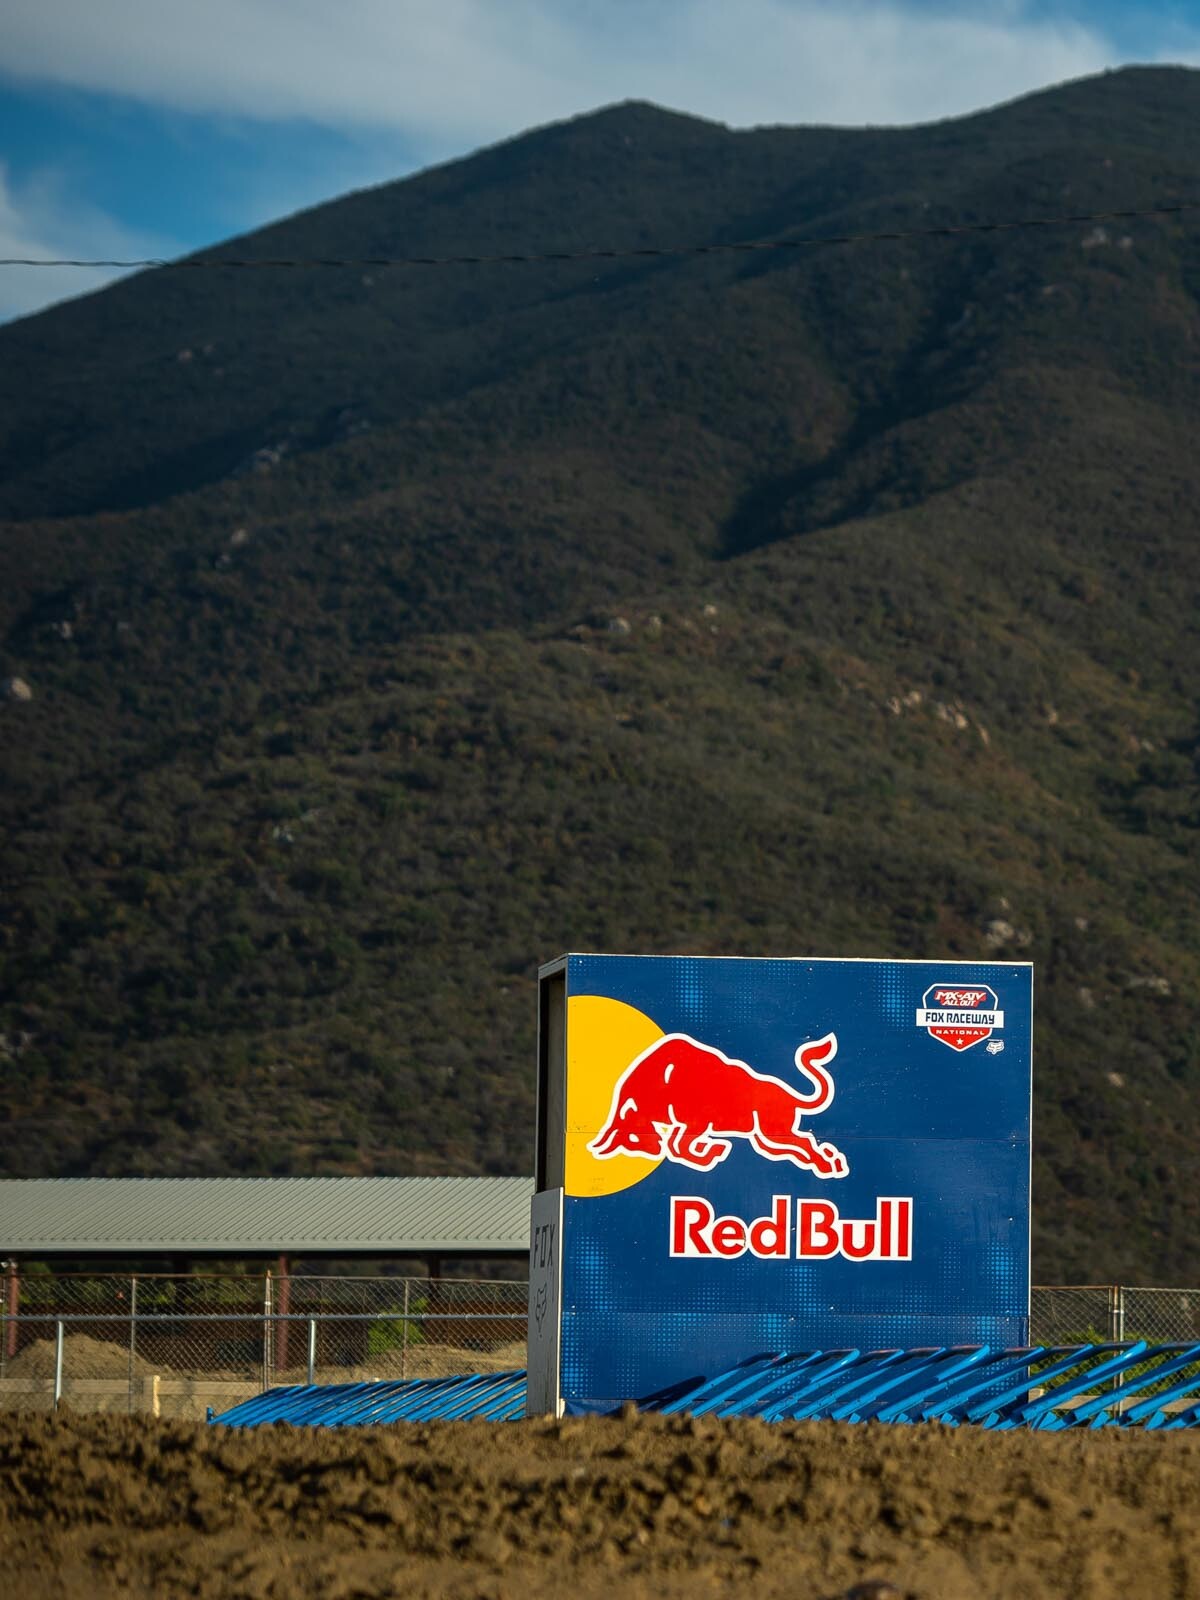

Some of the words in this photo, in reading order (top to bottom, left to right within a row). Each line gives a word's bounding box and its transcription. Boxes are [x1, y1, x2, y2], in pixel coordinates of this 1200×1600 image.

[925, 1012, 944, 1022] FOX
[946, 1013, 995, 1024] RACEWAY
[533, 1224, 555, 1269] FOX
[670, 1195, 791, 1259] Red
[796, 1197, 913, 1261] Bull
